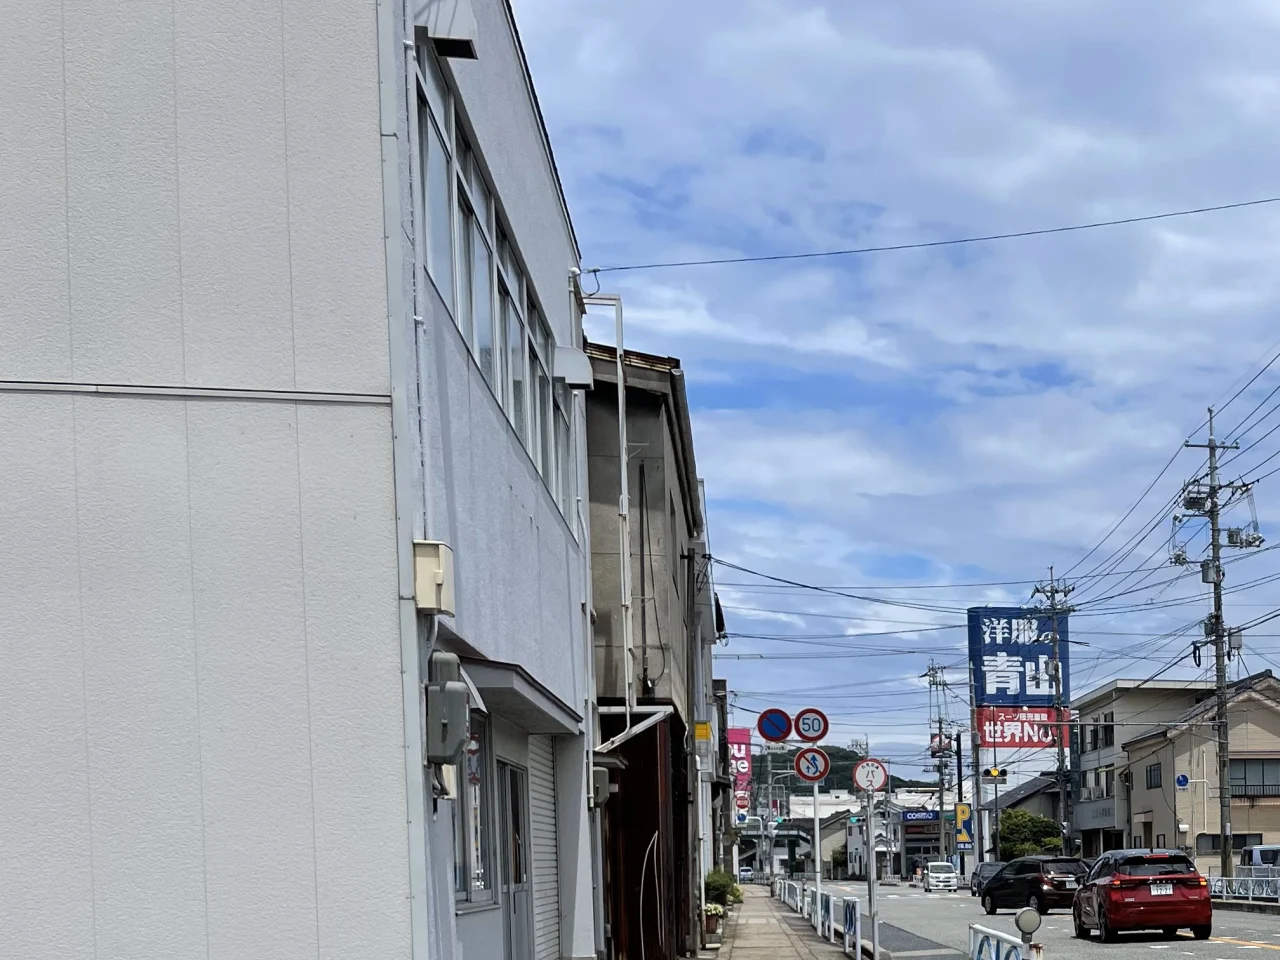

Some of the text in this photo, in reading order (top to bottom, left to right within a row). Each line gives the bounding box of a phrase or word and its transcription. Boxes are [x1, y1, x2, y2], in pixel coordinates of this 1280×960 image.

[981, 651, 1063, 695] 青山
[802, 718, 821, 733] 50
[865, 770, 875, 788] バス
